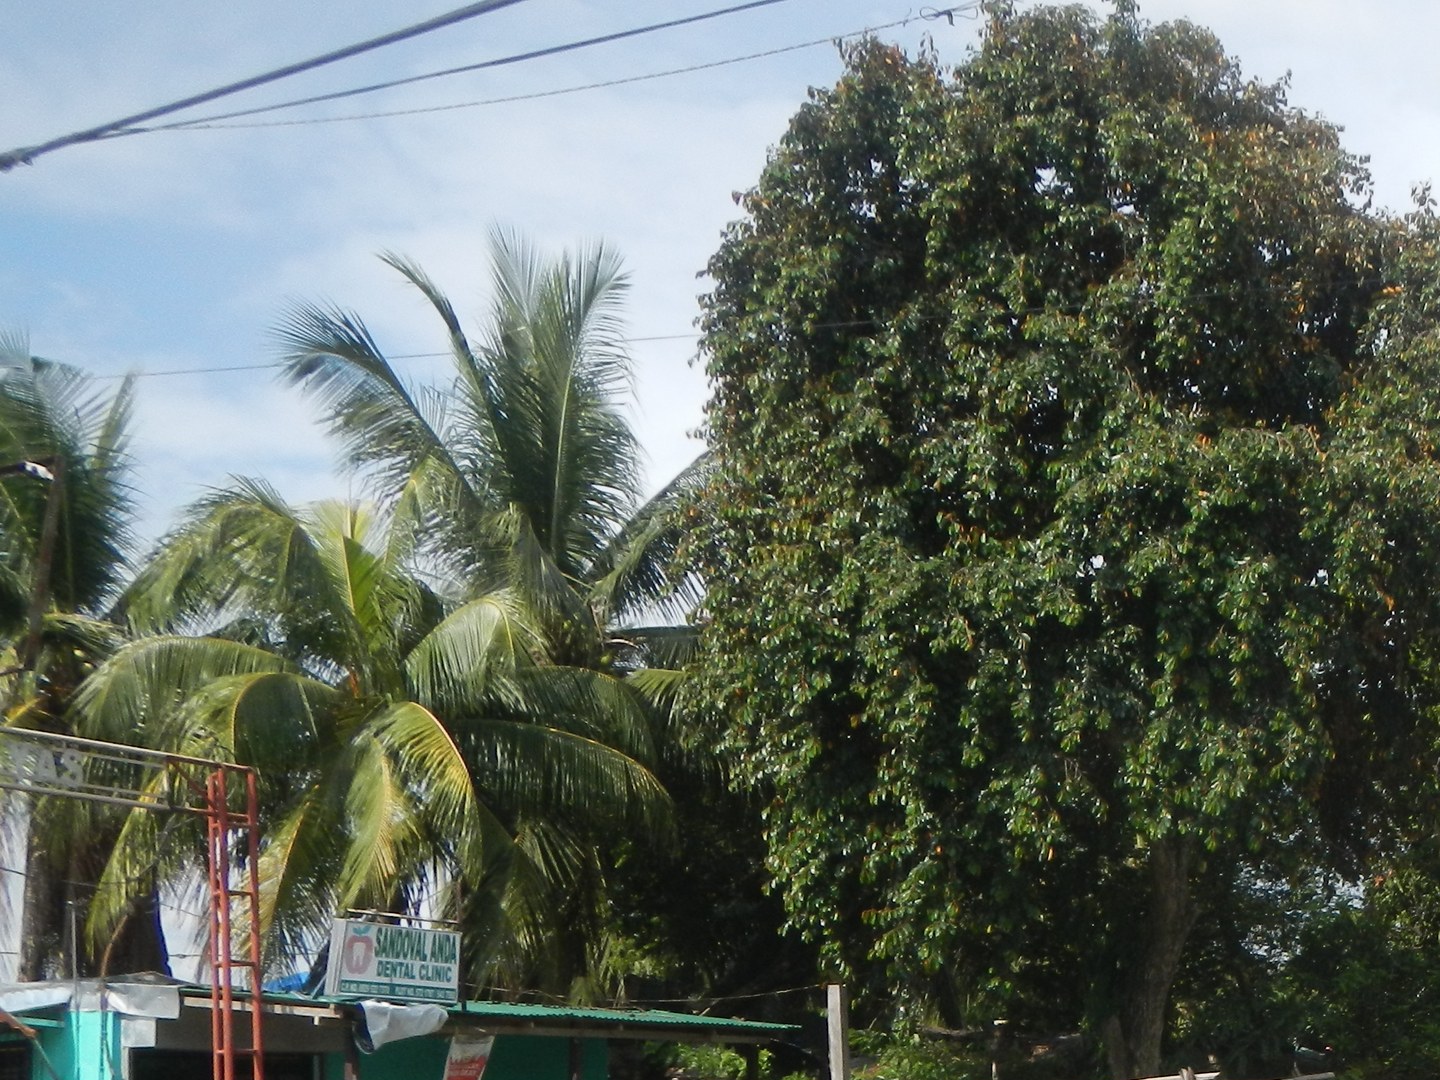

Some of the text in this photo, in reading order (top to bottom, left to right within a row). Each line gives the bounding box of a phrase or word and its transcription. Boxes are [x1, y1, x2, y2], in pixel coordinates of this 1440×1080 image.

[375, 928, 457, 964] SANDOVAL ANDA
[377, 961, 453, 983] DENTAL CLINIC
